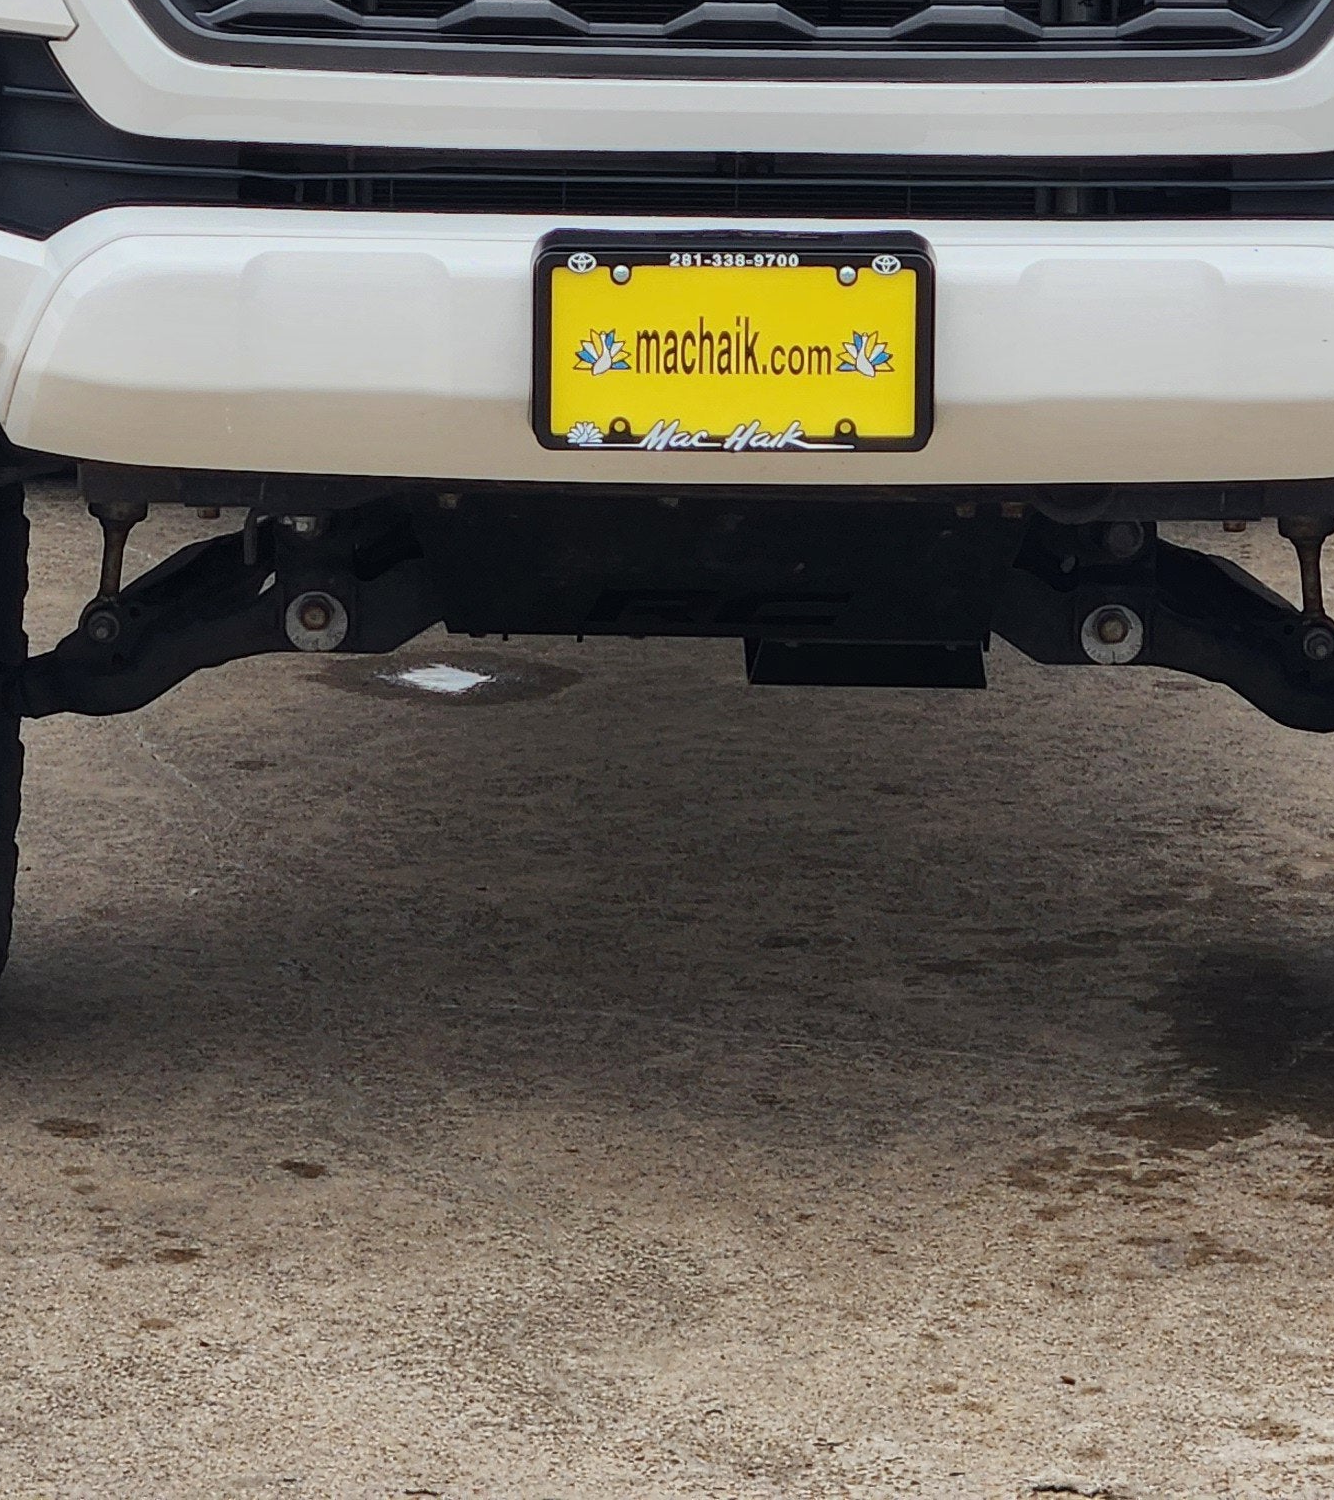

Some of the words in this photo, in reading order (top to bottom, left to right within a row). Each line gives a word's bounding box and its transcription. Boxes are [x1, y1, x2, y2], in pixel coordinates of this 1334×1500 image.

[669, 253, 799, 268] 281-338-9700
[635, 316, 832, 376] machaik.com
[640, 419, 715, 451] Mac
[723, 419, 809, 452] Haik
